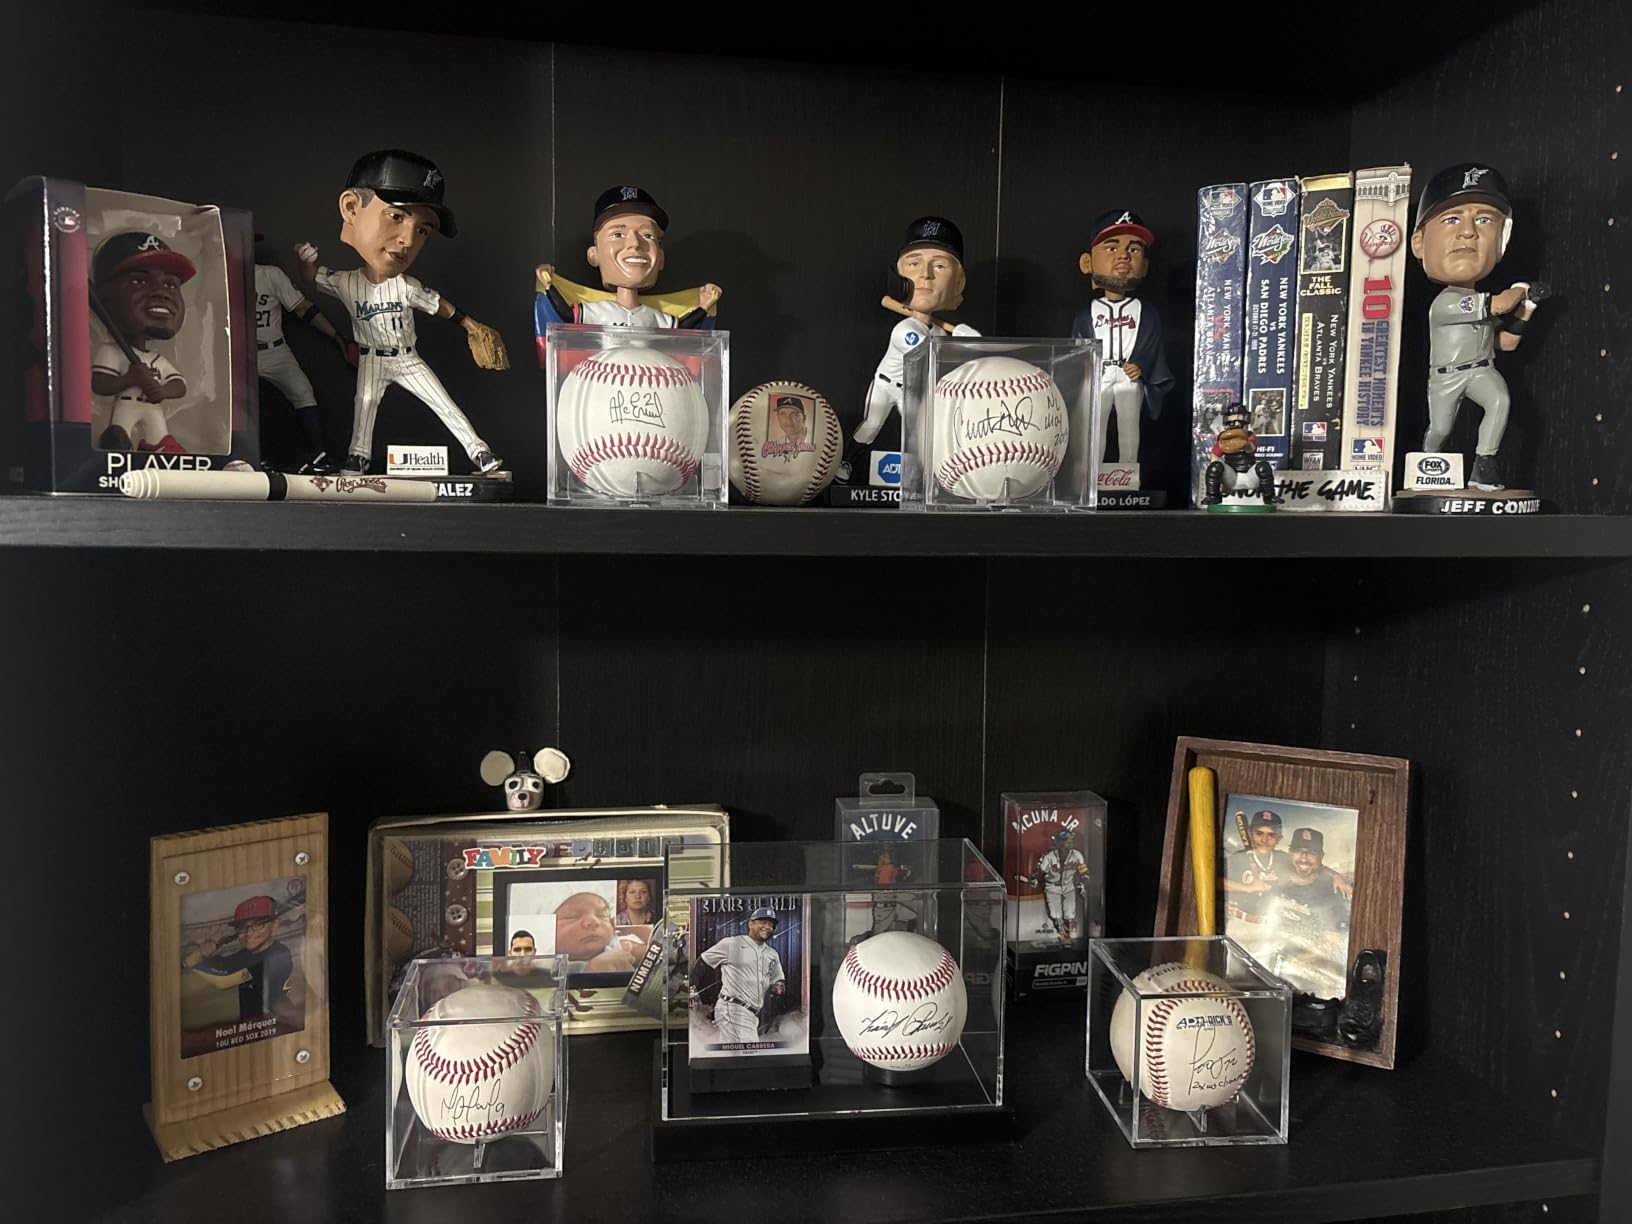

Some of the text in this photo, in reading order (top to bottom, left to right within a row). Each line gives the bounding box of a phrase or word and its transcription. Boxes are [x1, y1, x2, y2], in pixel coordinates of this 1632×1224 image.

[1115, 211, 1133, 224] A
[138, 235, 160, 251] A
[1309, 282, 1334, 290] FALL
[1311, 275, 1332, 283] THE
[1223, 279, 1232, 300] NEW
[1300, 287, 1342, 297] CLASSIC
[1363, 274, 1393, 320] 10
[355, 300, 403, 318] MARLINS
[1206, 286, 1216, 329] ATLANTA
[1223, 304, 1232, 329] YORK
[256, 310, 271, 328] 27
[1257, 279, 1270, 374] SAN DIEGO PADRES
[1276, 276, 1289, 375] NEW YORK YANKEES
[1313, 321, 1326, 402] ATLANTA BRAVES
[1326, 313, 1339, 409] NEW YORK YANKEES
[1356, 322, 1375, 426] IN YANKEE HISTORY
[1370, 320, 1390, 427] GREATEST MOMENTS
[107, 452, 212, 475] PLAYER
[882, 463, 902, 474] ADT
[1424, 460, 1443, 469] FOX
[99, 477, 120, 488] SH
[437, 483, 474, 497] ALEZ
[1274, 480, 1314, 500] THE
[1416, 476, 1451, 486] FLORIDA
[850, 489, 902, 502] KYLE STO
[1120, 494, 1150, 506] LÓPEZ
[1441, 500, 1486, 513] JEFF
[850, 813, 918, 841] ALTUVE
[1060, 814, 1080, 832] JR
[464, 848, 541, 868] FAMILY
[702, 896, 744, 913] STARS
[630, 944, 661, 992] NUMBER
[215, 1017, 277, 1039] Noel Márquez
[230, 1036, 244, 1045] RED
[245, 1032, 259, 1041] SOX
